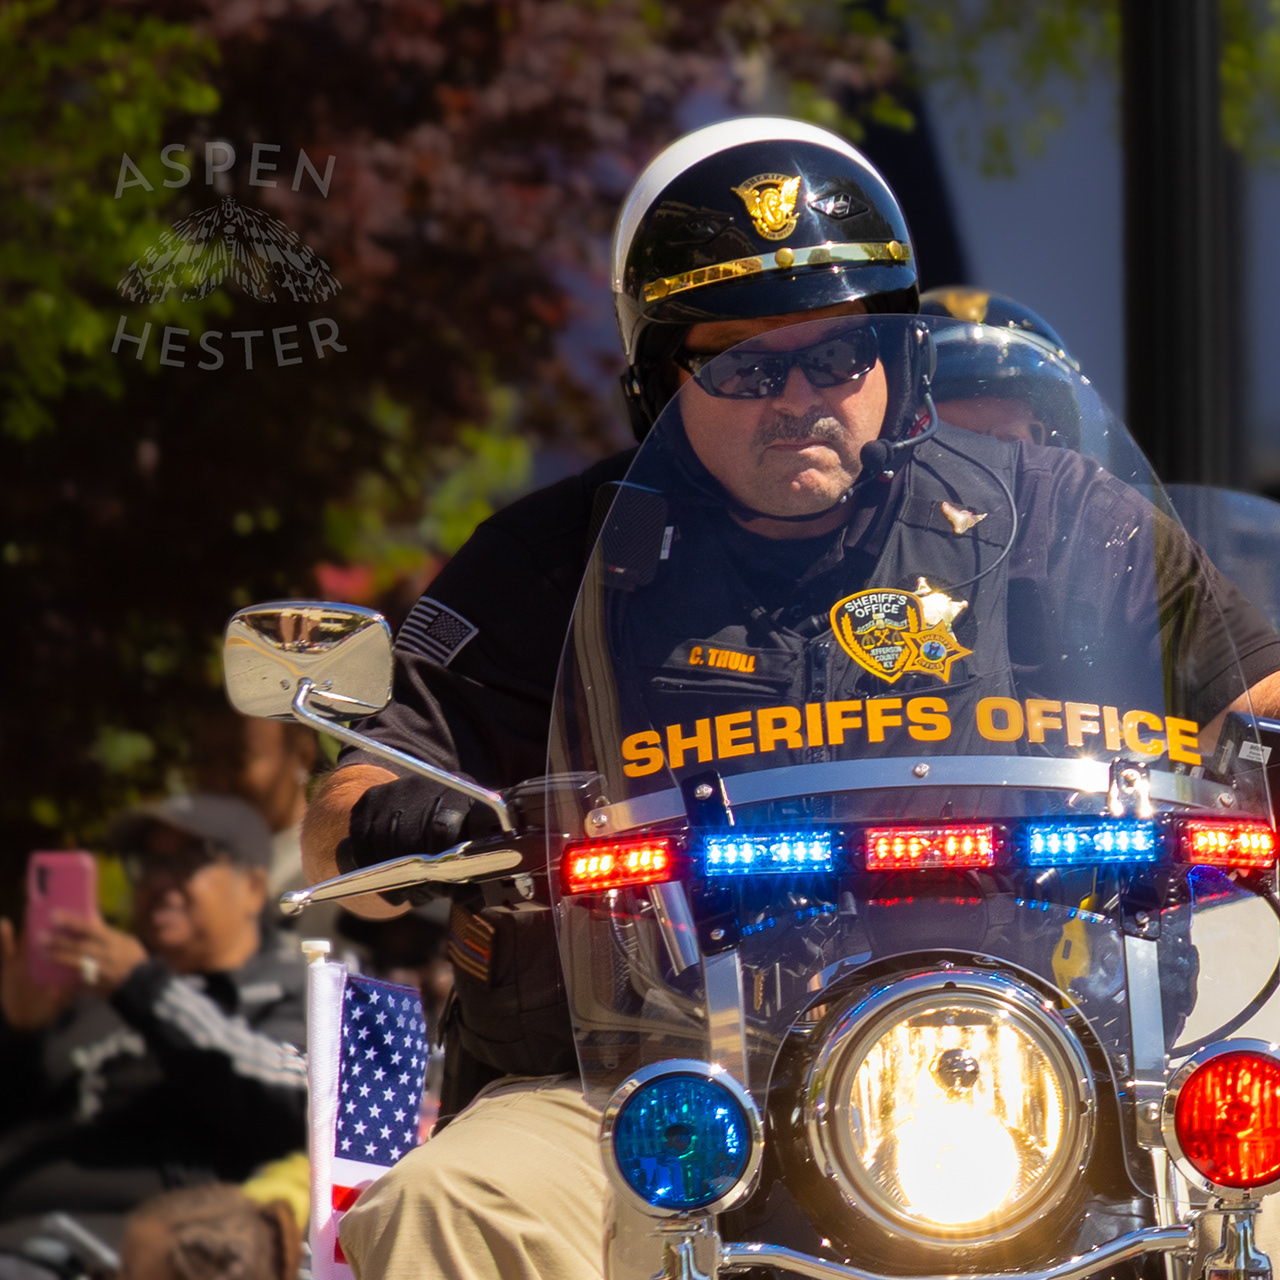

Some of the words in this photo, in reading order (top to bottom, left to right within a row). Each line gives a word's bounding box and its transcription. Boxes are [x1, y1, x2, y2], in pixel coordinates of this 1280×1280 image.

[844, 594, 907, 612] SHERIFF'S
[855, 603, 900, 618] OFFICE
[689, 646, 704, 665] C.
[708, 648, 755, 673] THULL
[621, 696, 952, 778] SHERIFFS
[976, 696, 1202, 765] OFFICE
